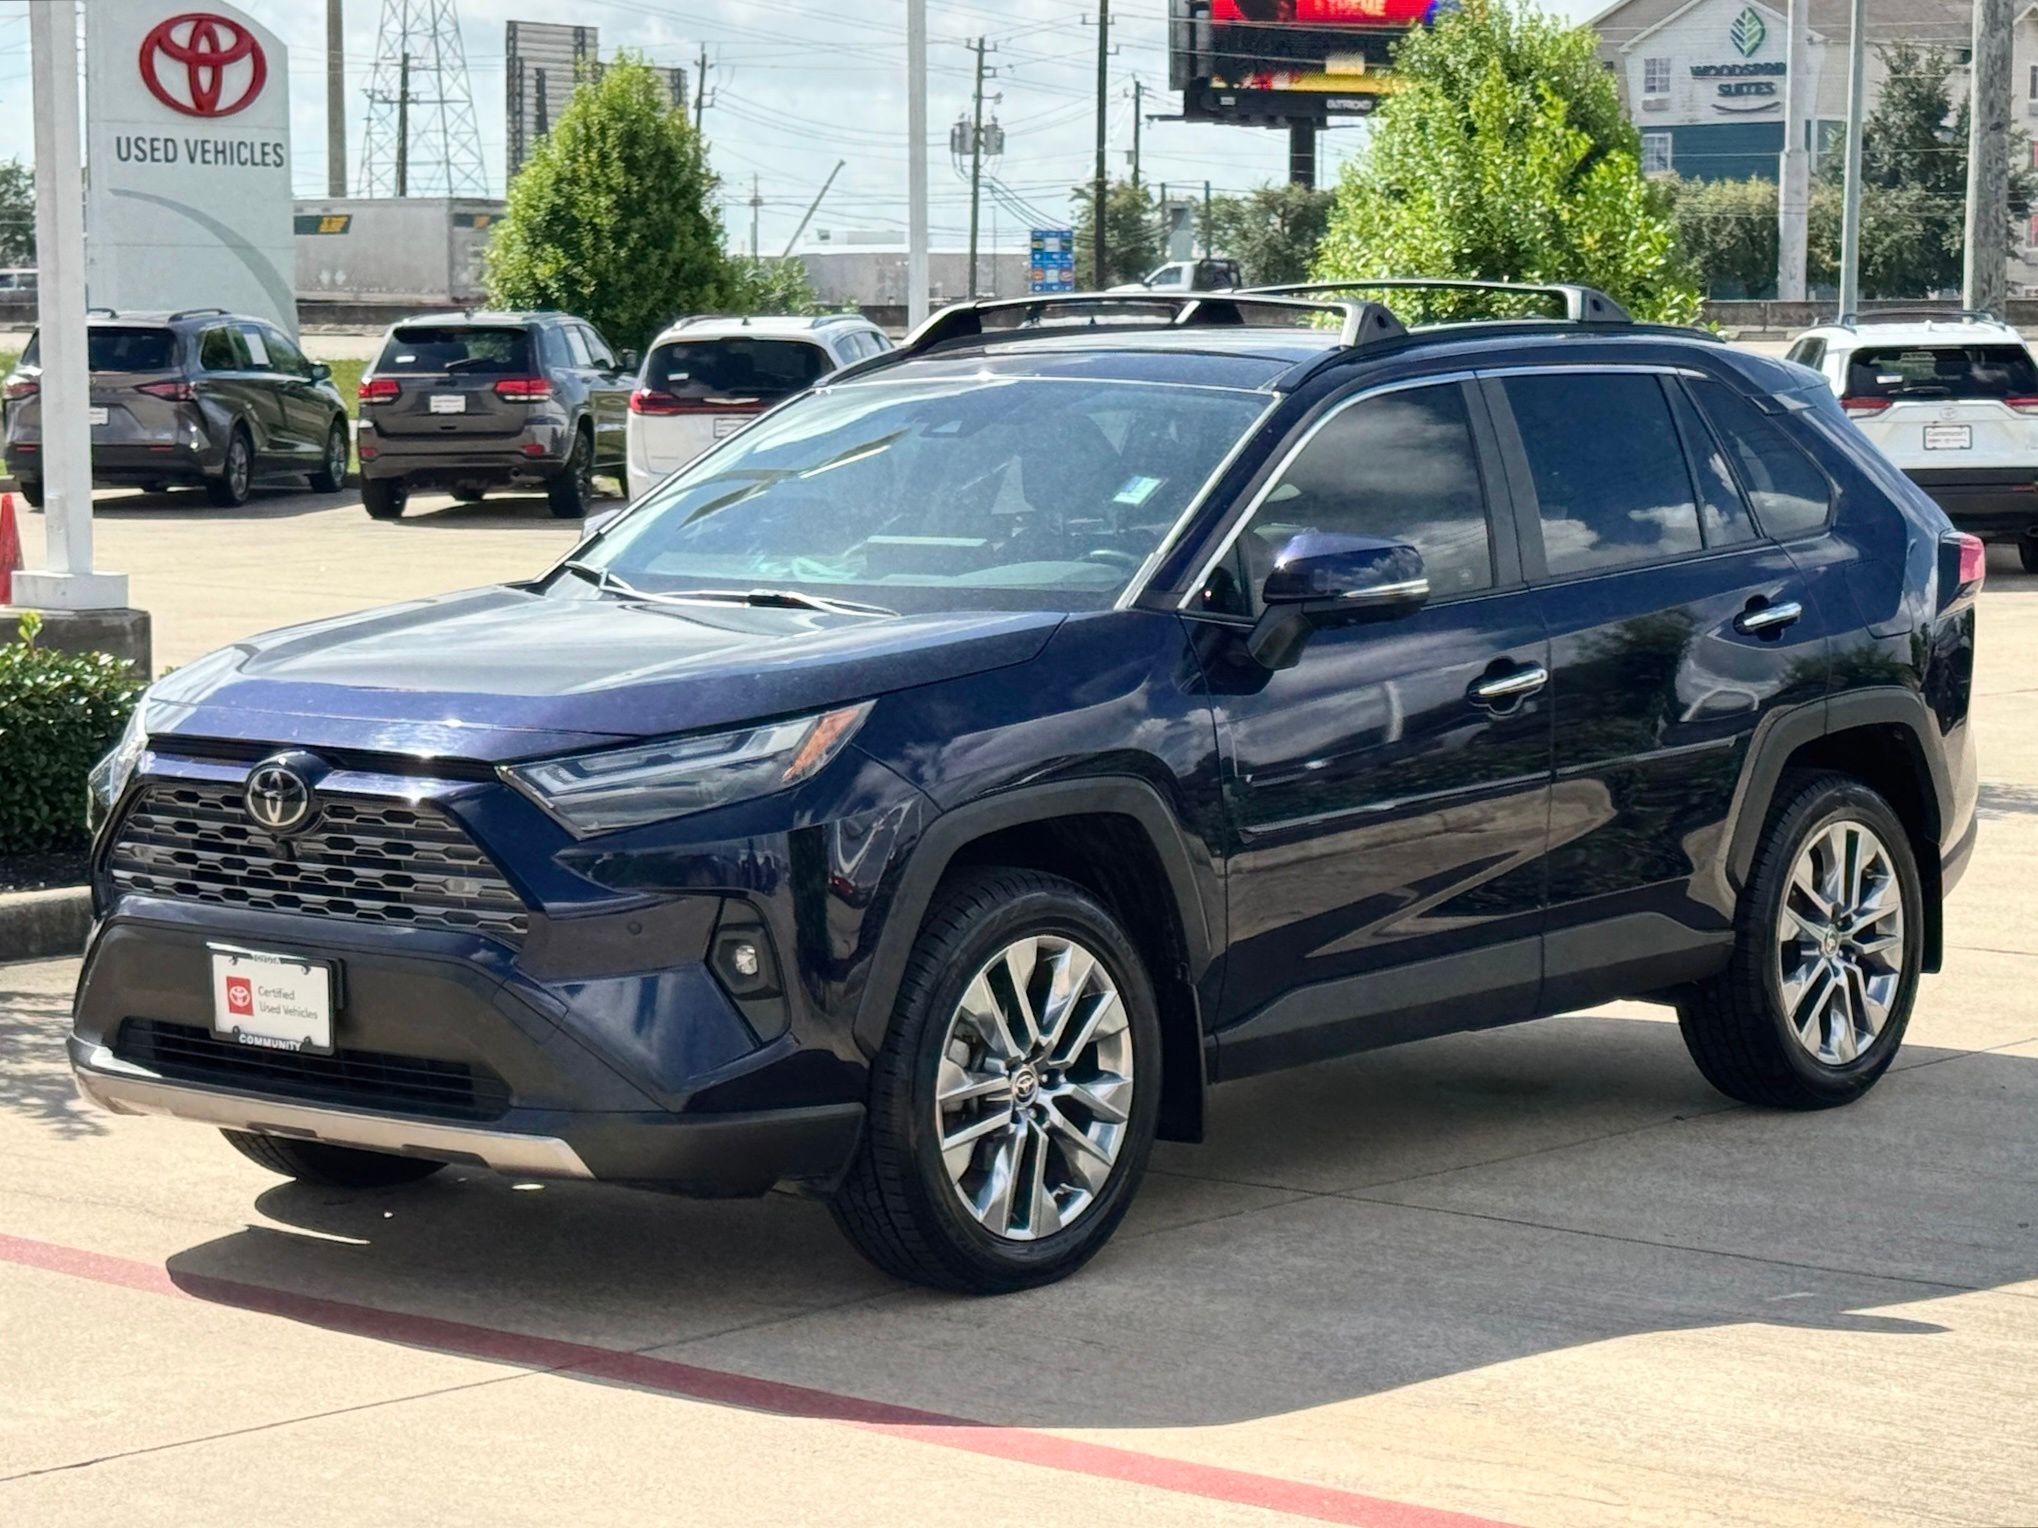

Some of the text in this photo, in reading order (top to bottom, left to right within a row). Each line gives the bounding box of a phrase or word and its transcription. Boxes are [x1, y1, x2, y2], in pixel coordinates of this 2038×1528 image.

[116, 136, 285, 168] USED VEHICLES
[258, 986, 295, 1000] Certified
[259, 1001, 318, 1019] Used Vehicles
[239, 1033, 302, 1051] COMMUNITY
